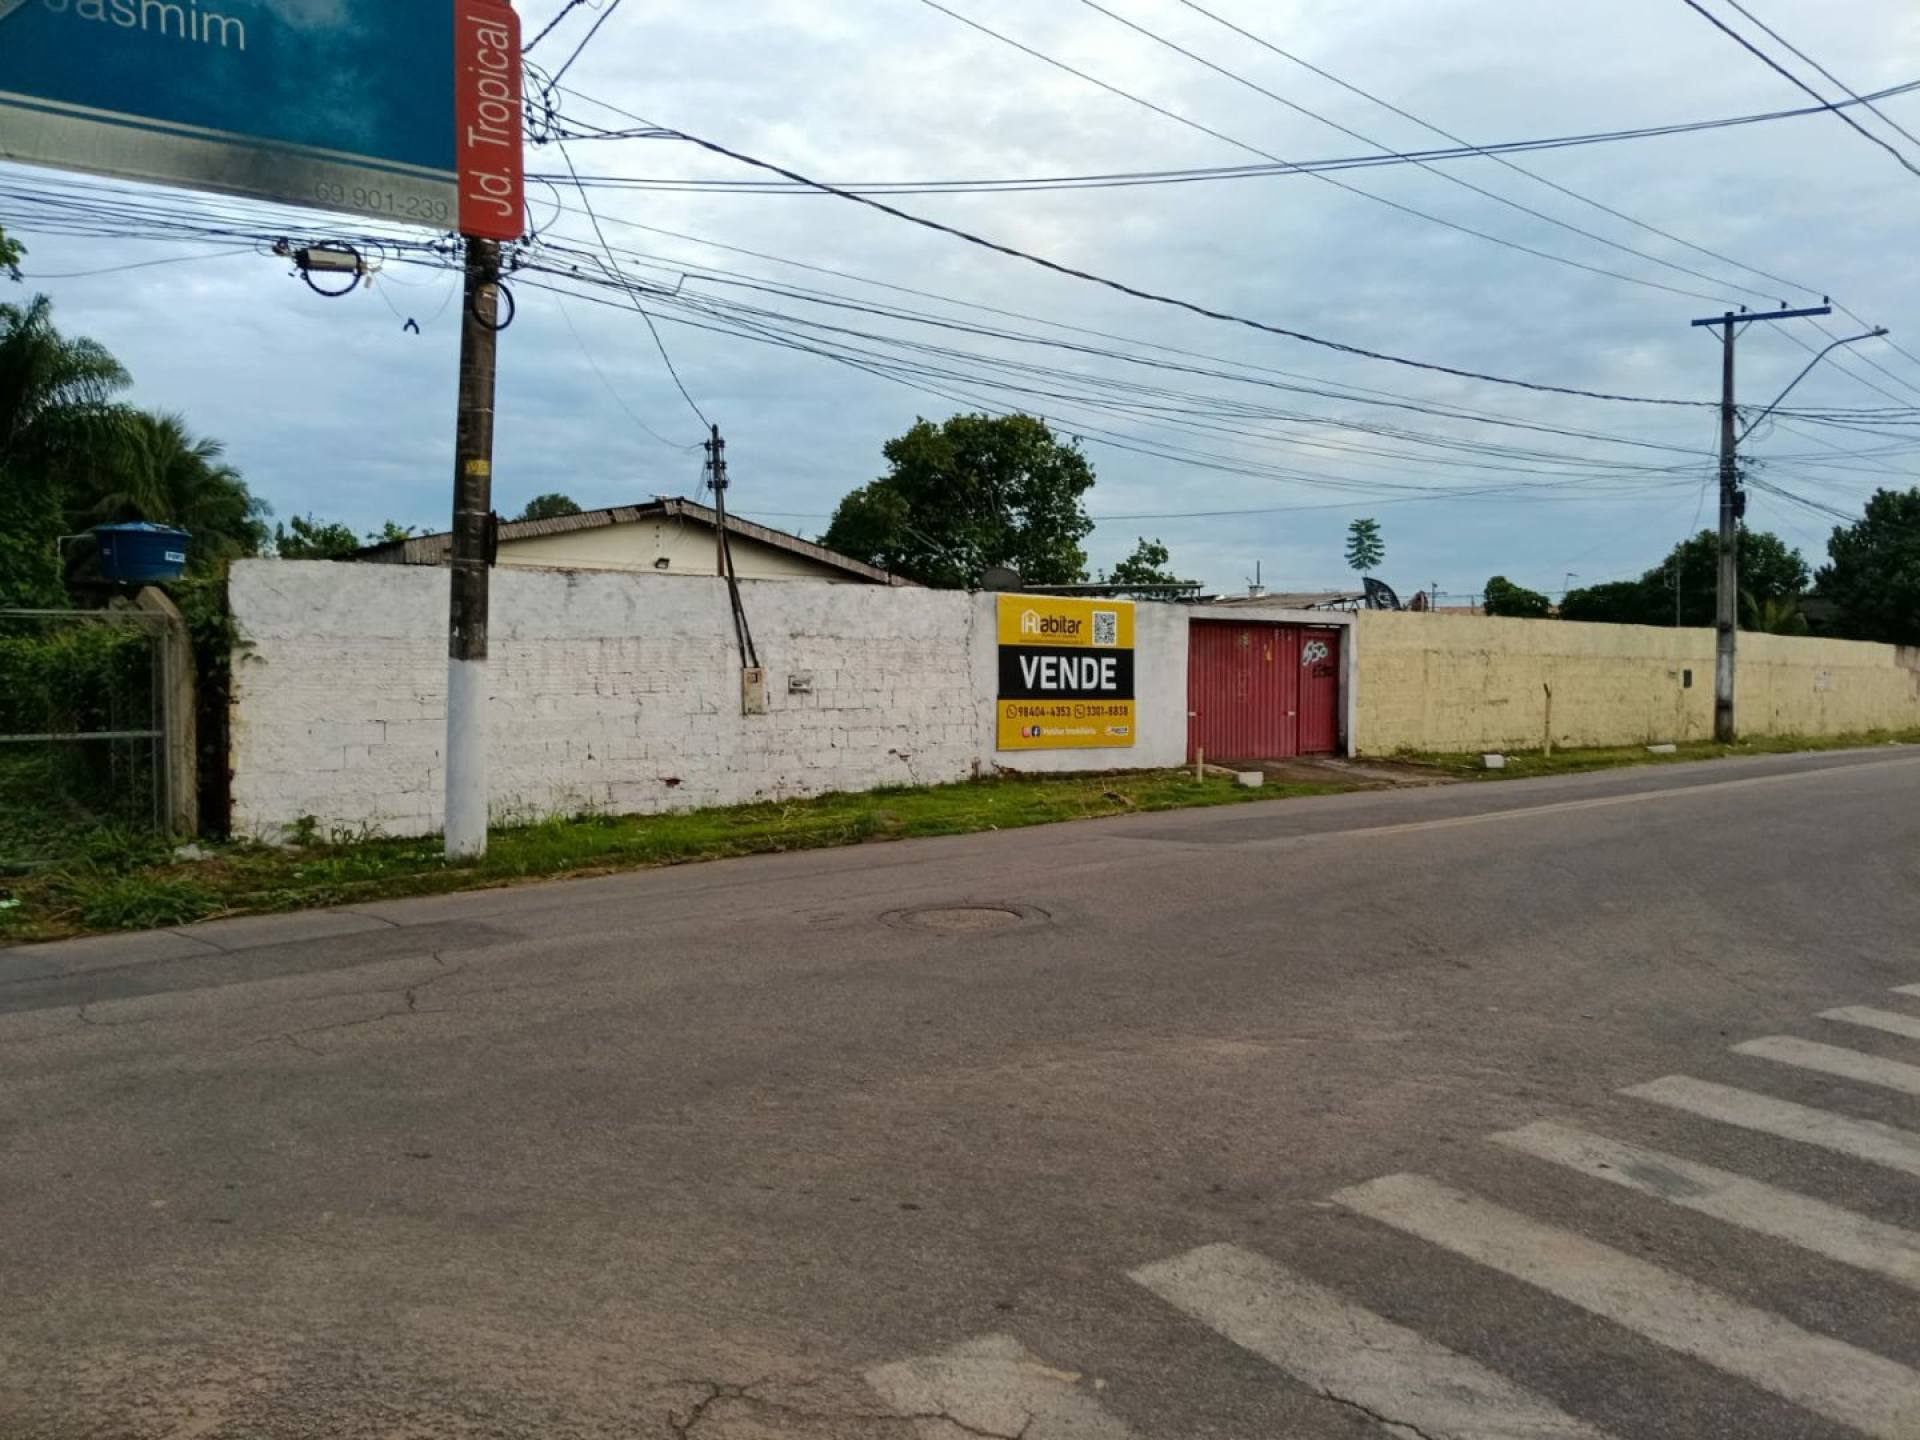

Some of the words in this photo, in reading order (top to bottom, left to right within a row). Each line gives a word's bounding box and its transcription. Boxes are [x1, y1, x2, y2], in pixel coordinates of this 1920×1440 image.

[45, 0, 245, 51] asmim
[466, 15, 520, 147] Tropical
[314, 182, 345, 203] 69
[352, 187, 449, 221] 901-239
[468, 166, 513, 217] Jd.
[1021, 609, 1082, 634] Habitar
[1019, 655, 1117, 690] VENDE
